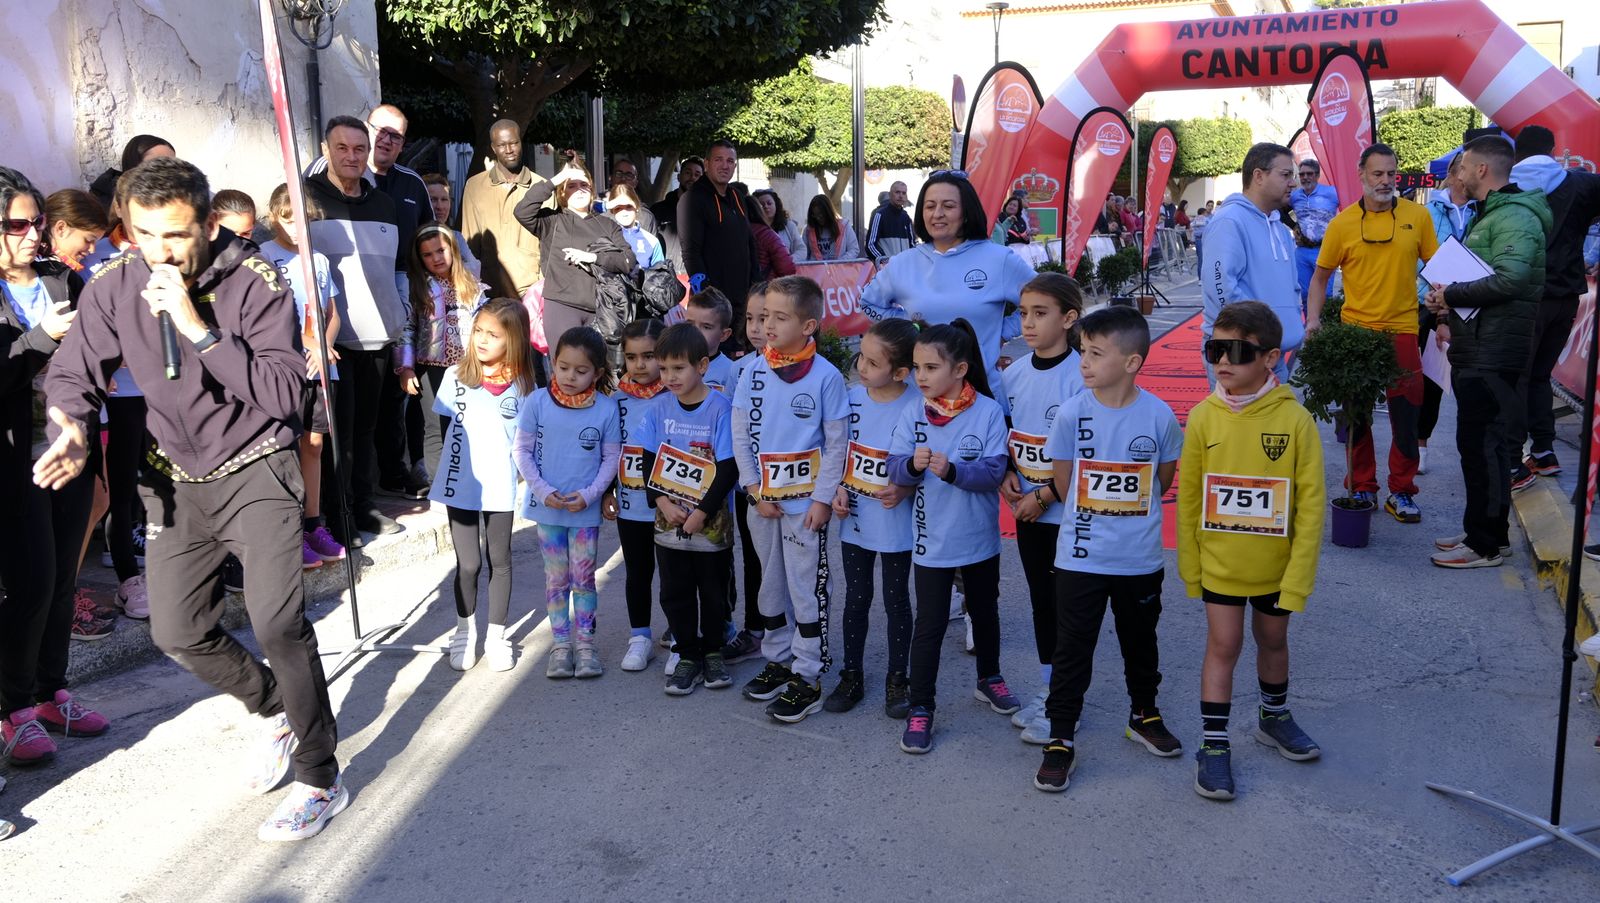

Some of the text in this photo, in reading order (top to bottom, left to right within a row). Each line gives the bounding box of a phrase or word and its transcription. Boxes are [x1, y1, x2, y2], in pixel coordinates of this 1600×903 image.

[1176, 9, 1399, 40] AYUNTAMIENTO
[1181, 38, 1389, 80] CANTOA
[750, 370, 767, 391] LA
[443, 379, 467, 498] LA POLVORILLA
[914, 421, 928, 443] LA
[1078, 417, 1094, 442] LA
[665, 457, 704, 483] 734
[769, 461, 810, 480] 716
[1089, 473, 1139, 493] 728
[1218, 488, 1270, 509] 751
